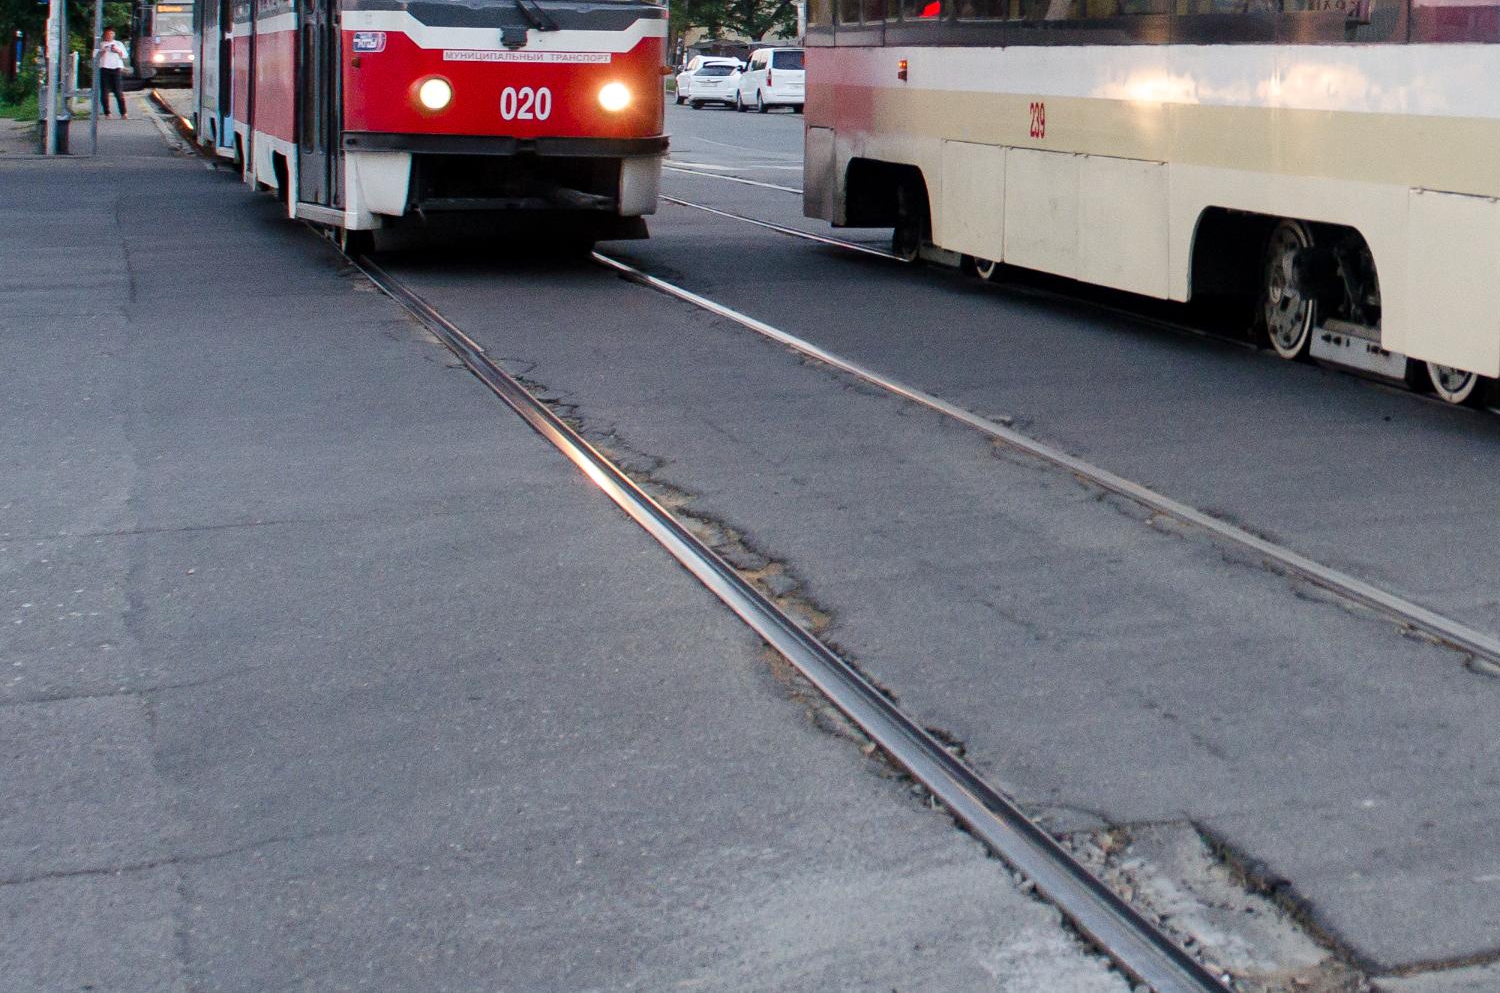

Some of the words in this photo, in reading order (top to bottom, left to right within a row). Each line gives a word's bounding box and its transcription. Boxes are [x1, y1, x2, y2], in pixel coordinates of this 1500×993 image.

[445, 51, 544, 62] МУНИЦИПАЛЬНЫЙ
[551, 53, 610, 63] ТРАНСПОРТ
[500, 86, 552, 121] 020
[1030, 102, 1045, 138] 239
